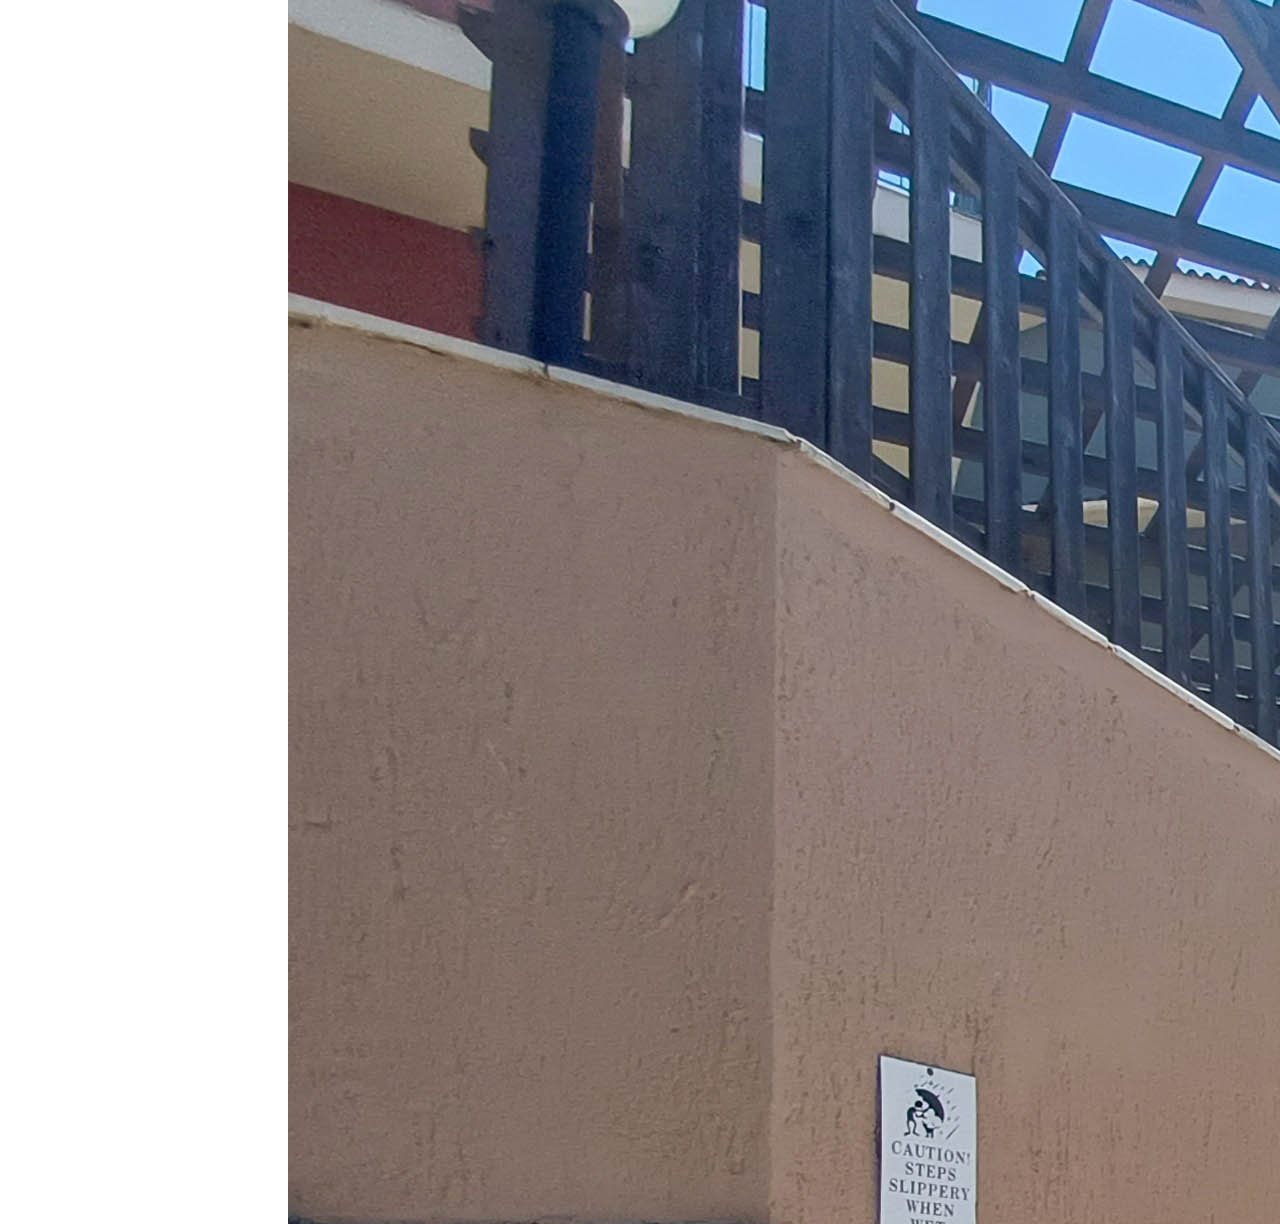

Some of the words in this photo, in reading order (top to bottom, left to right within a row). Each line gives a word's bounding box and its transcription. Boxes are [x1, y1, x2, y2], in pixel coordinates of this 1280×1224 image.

[891, 1140, 970, 1164] CAUTION!
[905, 1162, 956, 1181] STEPS
[888, 1178, 970, 1201] SLIPPERY
[906, 1199, 955, 1217] WHEN
